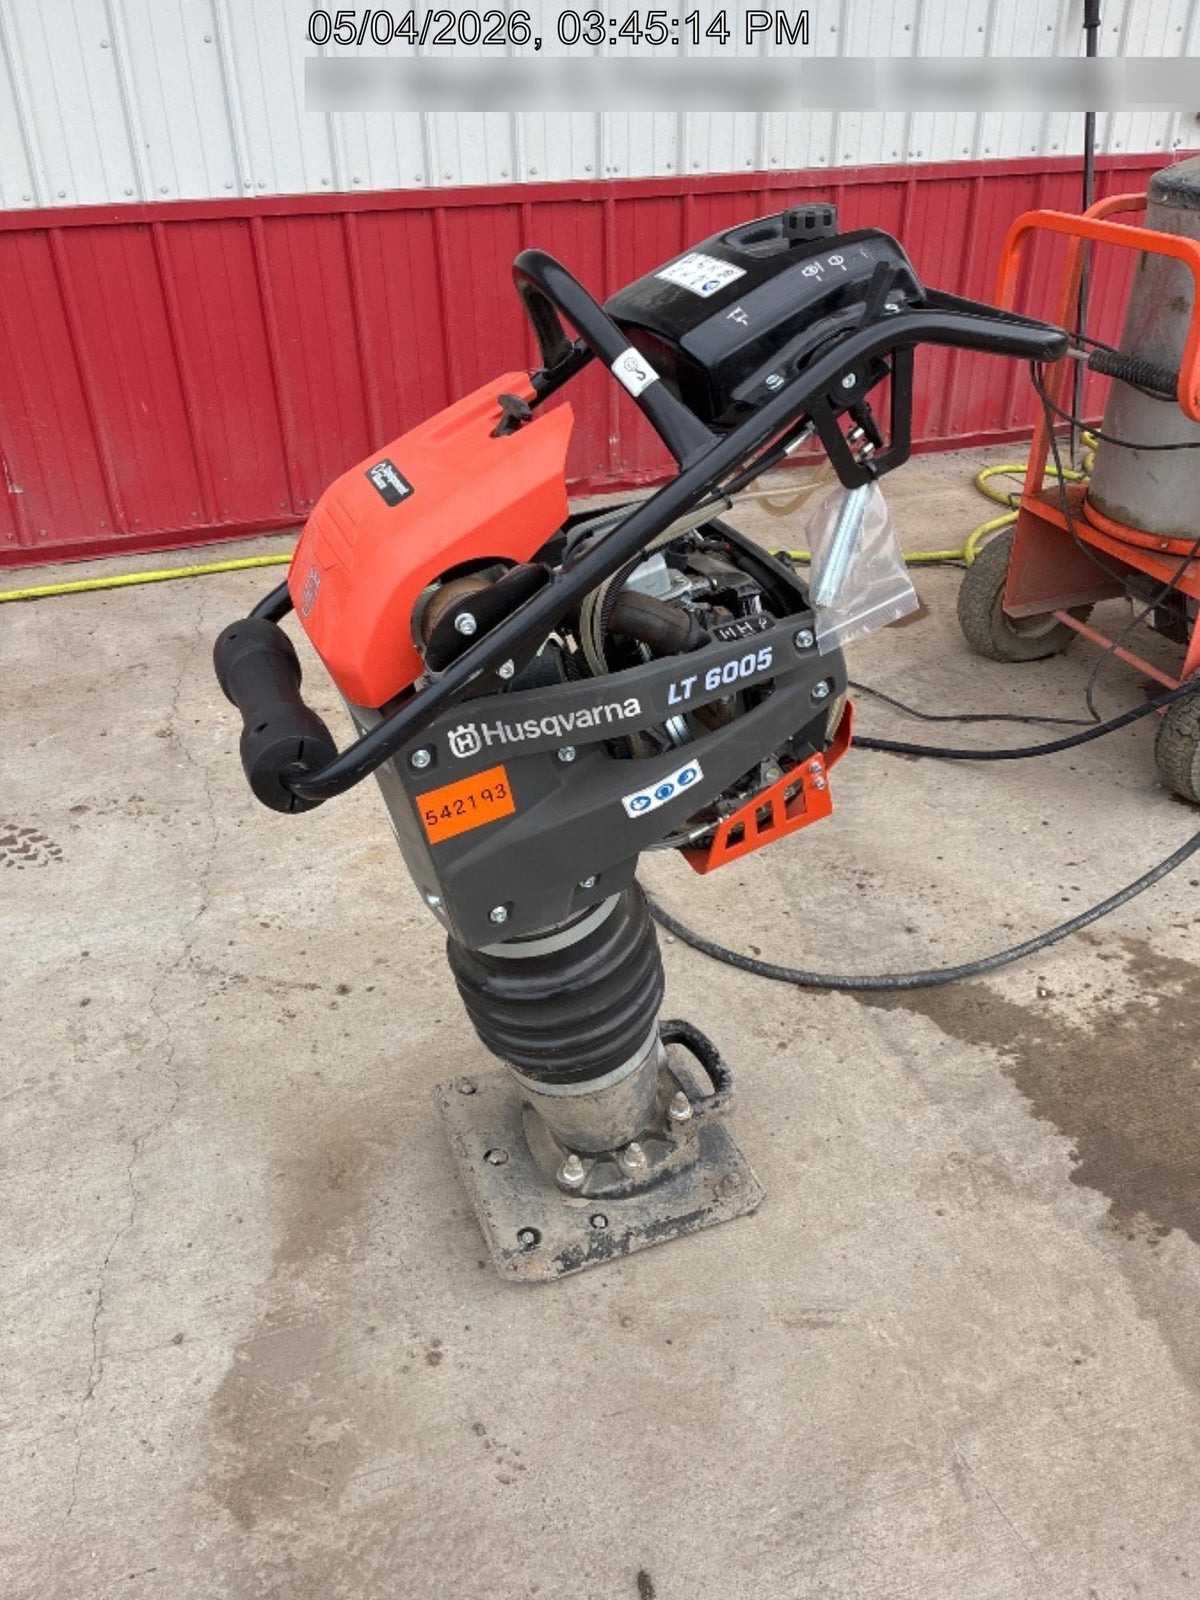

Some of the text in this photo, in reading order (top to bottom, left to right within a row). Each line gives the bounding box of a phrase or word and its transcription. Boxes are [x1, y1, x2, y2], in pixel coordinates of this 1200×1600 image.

[668, 646, 773, 705] LT 6005
[481, 698, 643, 746] Husqvarna
[425, 784, 507, 826] 542193
